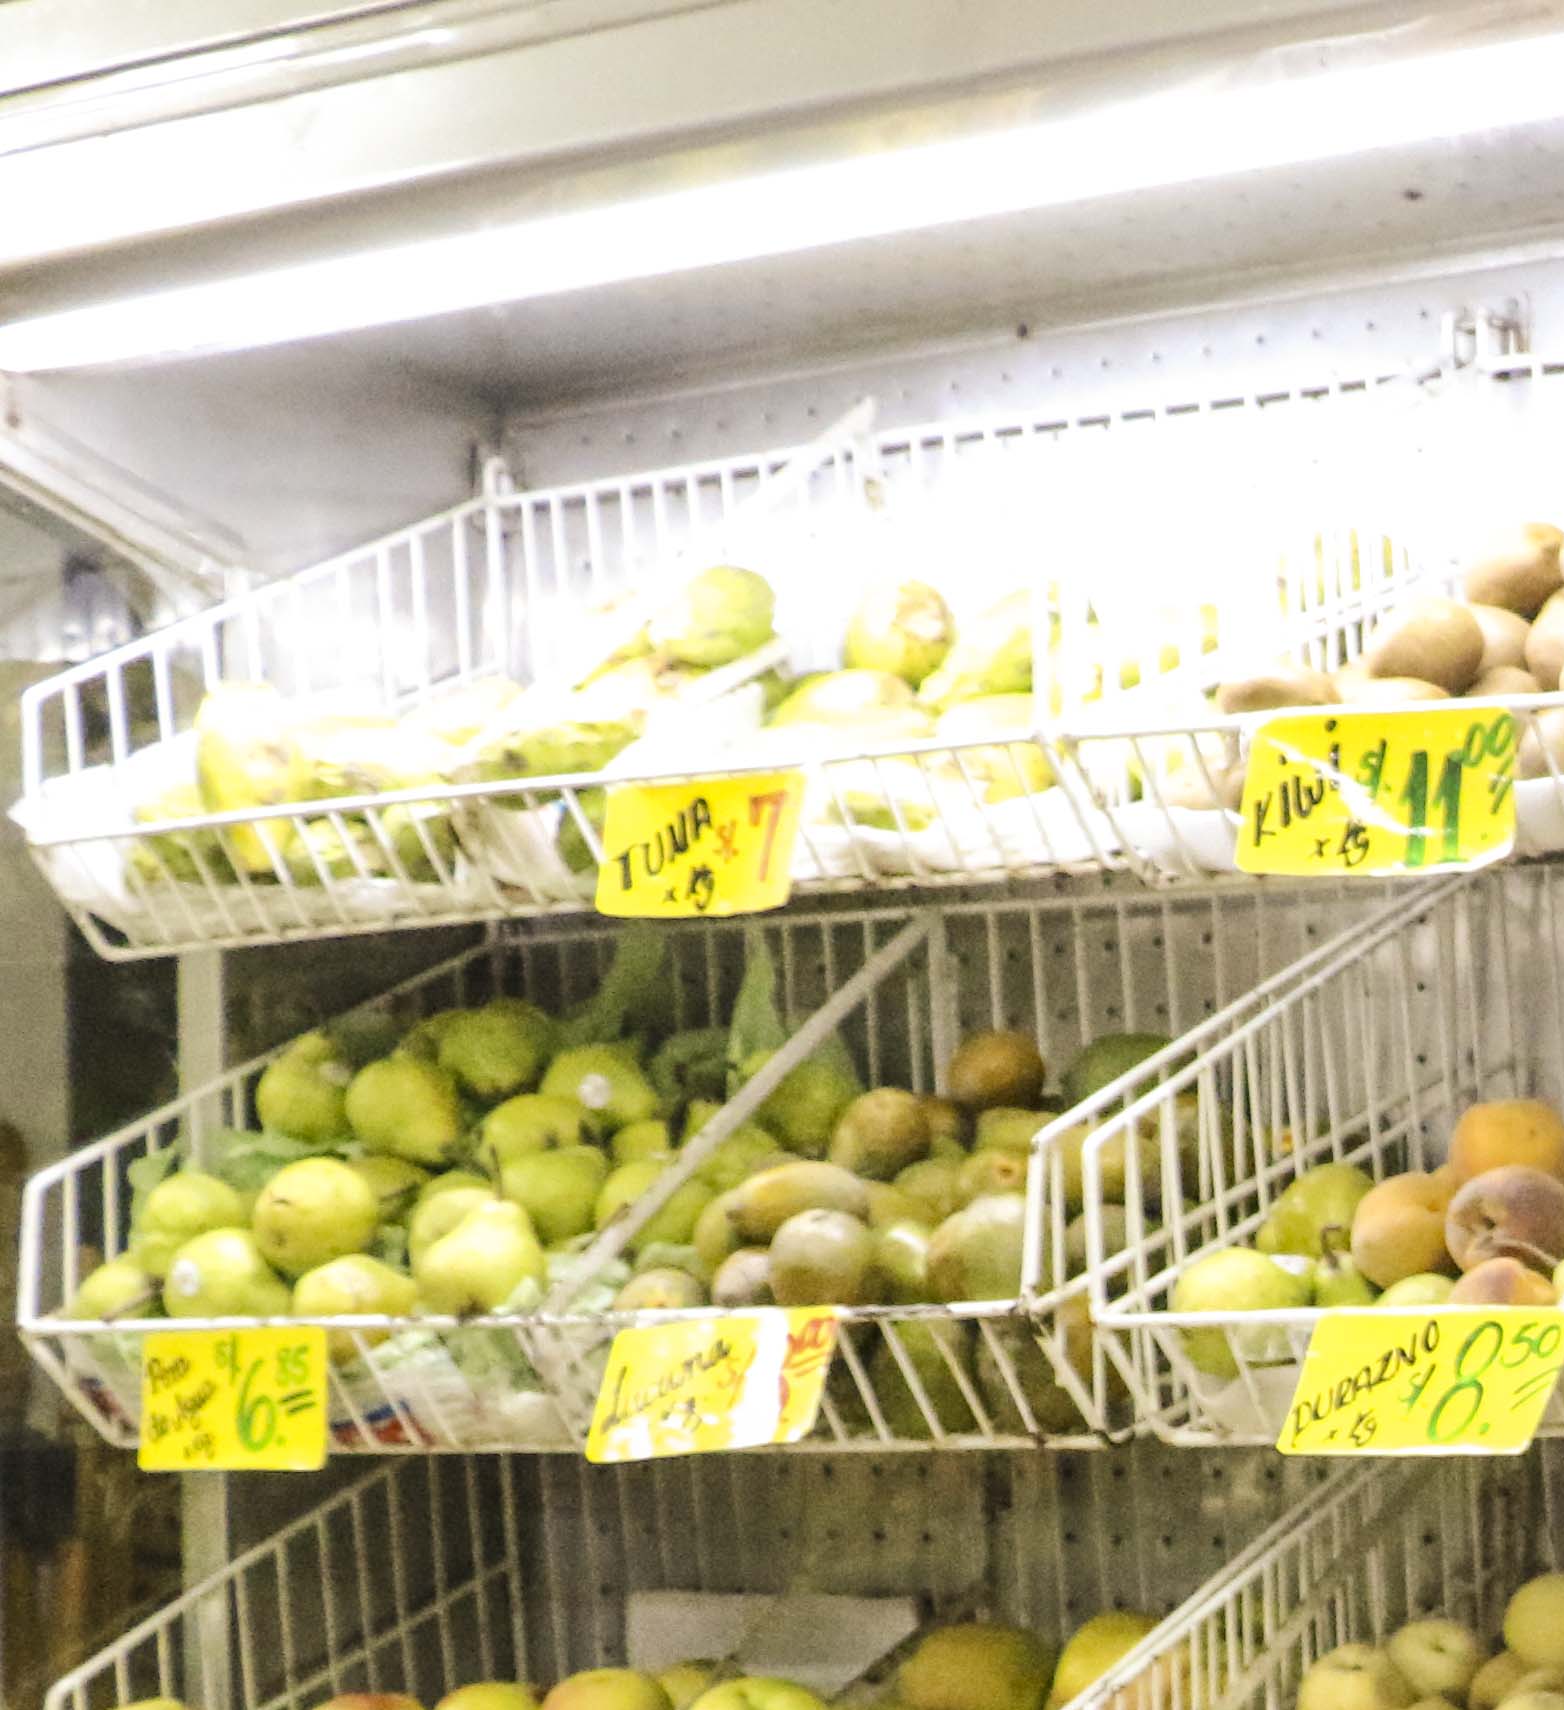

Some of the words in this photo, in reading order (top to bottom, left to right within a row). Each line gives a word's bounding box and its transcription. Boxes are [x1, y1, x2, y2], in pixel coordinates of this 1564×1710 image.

[611, 797, 714, 891] TUNA
[748, 790, 788, 882] 7
[1291, 1319, 1442, 1442] DURAZNO
